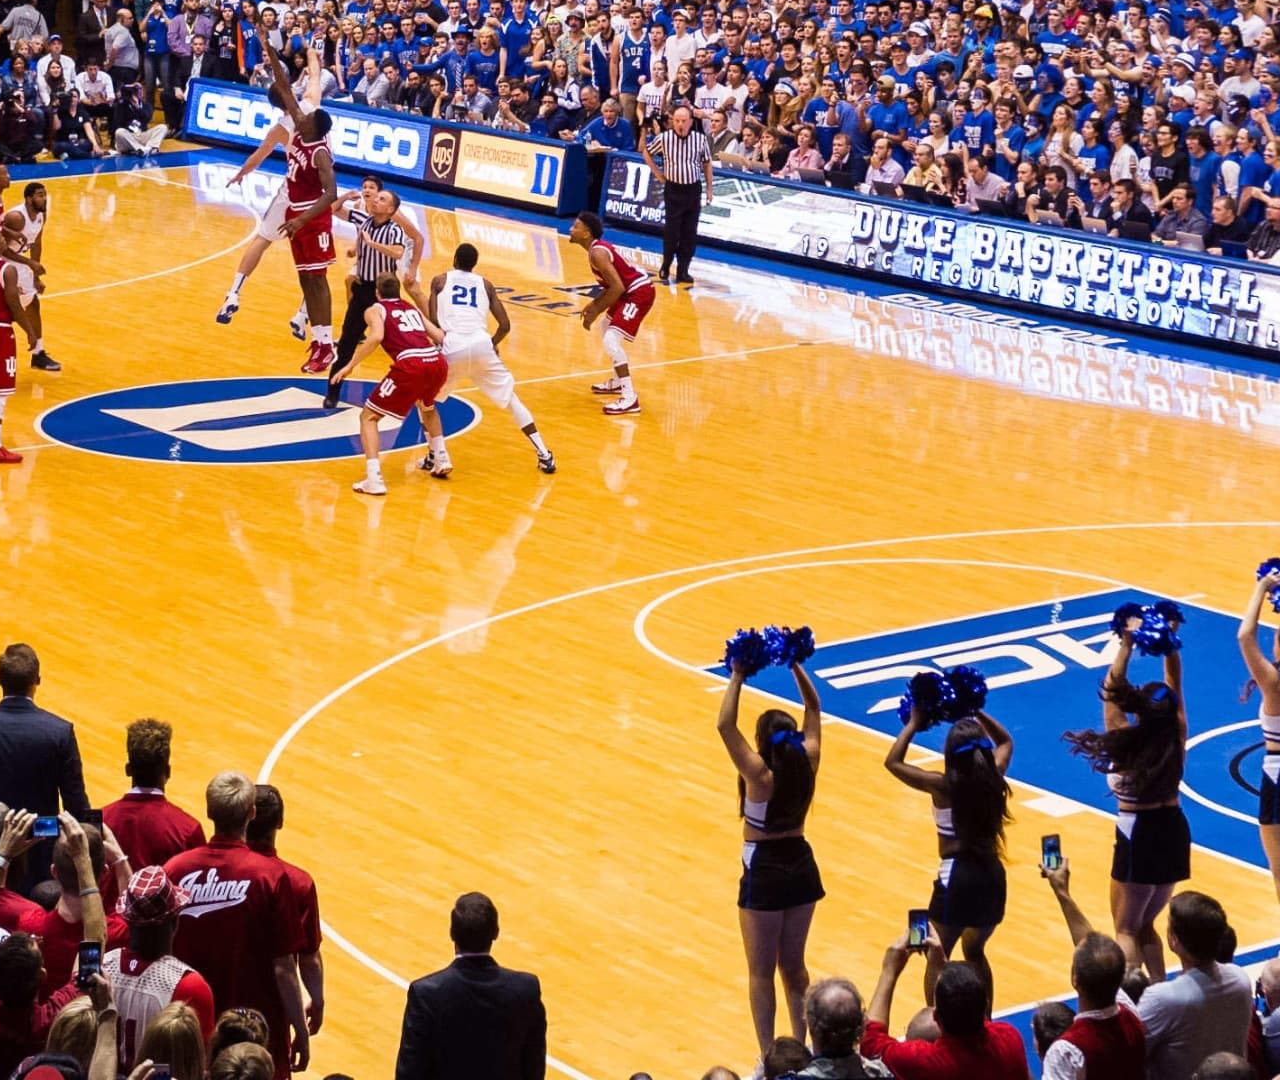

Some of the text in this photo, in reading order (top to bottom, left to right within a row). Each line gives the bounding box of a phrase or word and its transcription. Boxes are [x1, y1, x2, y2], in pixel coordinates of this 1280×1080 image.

[631, 57, 641, 69] 4
[335, 115, 420, 170] EICO
[433, 146, 453, 171] ups
[530, 153, 559, 197] D
[622, 162, 652, 202] D
[851, 203, 1261, 314] DUKE BASKETBALL
[451, 285, 478, 309] 21
[802, 234, 828, 258] 19
[846, 244, 894, 270] ACC
[911, 257, 1043, 301] REGULAR
[1062, 286, 1184, 331] SEASON
[391, 308, 424, 333] 30
[179, 867, 251, 906] Indiana
